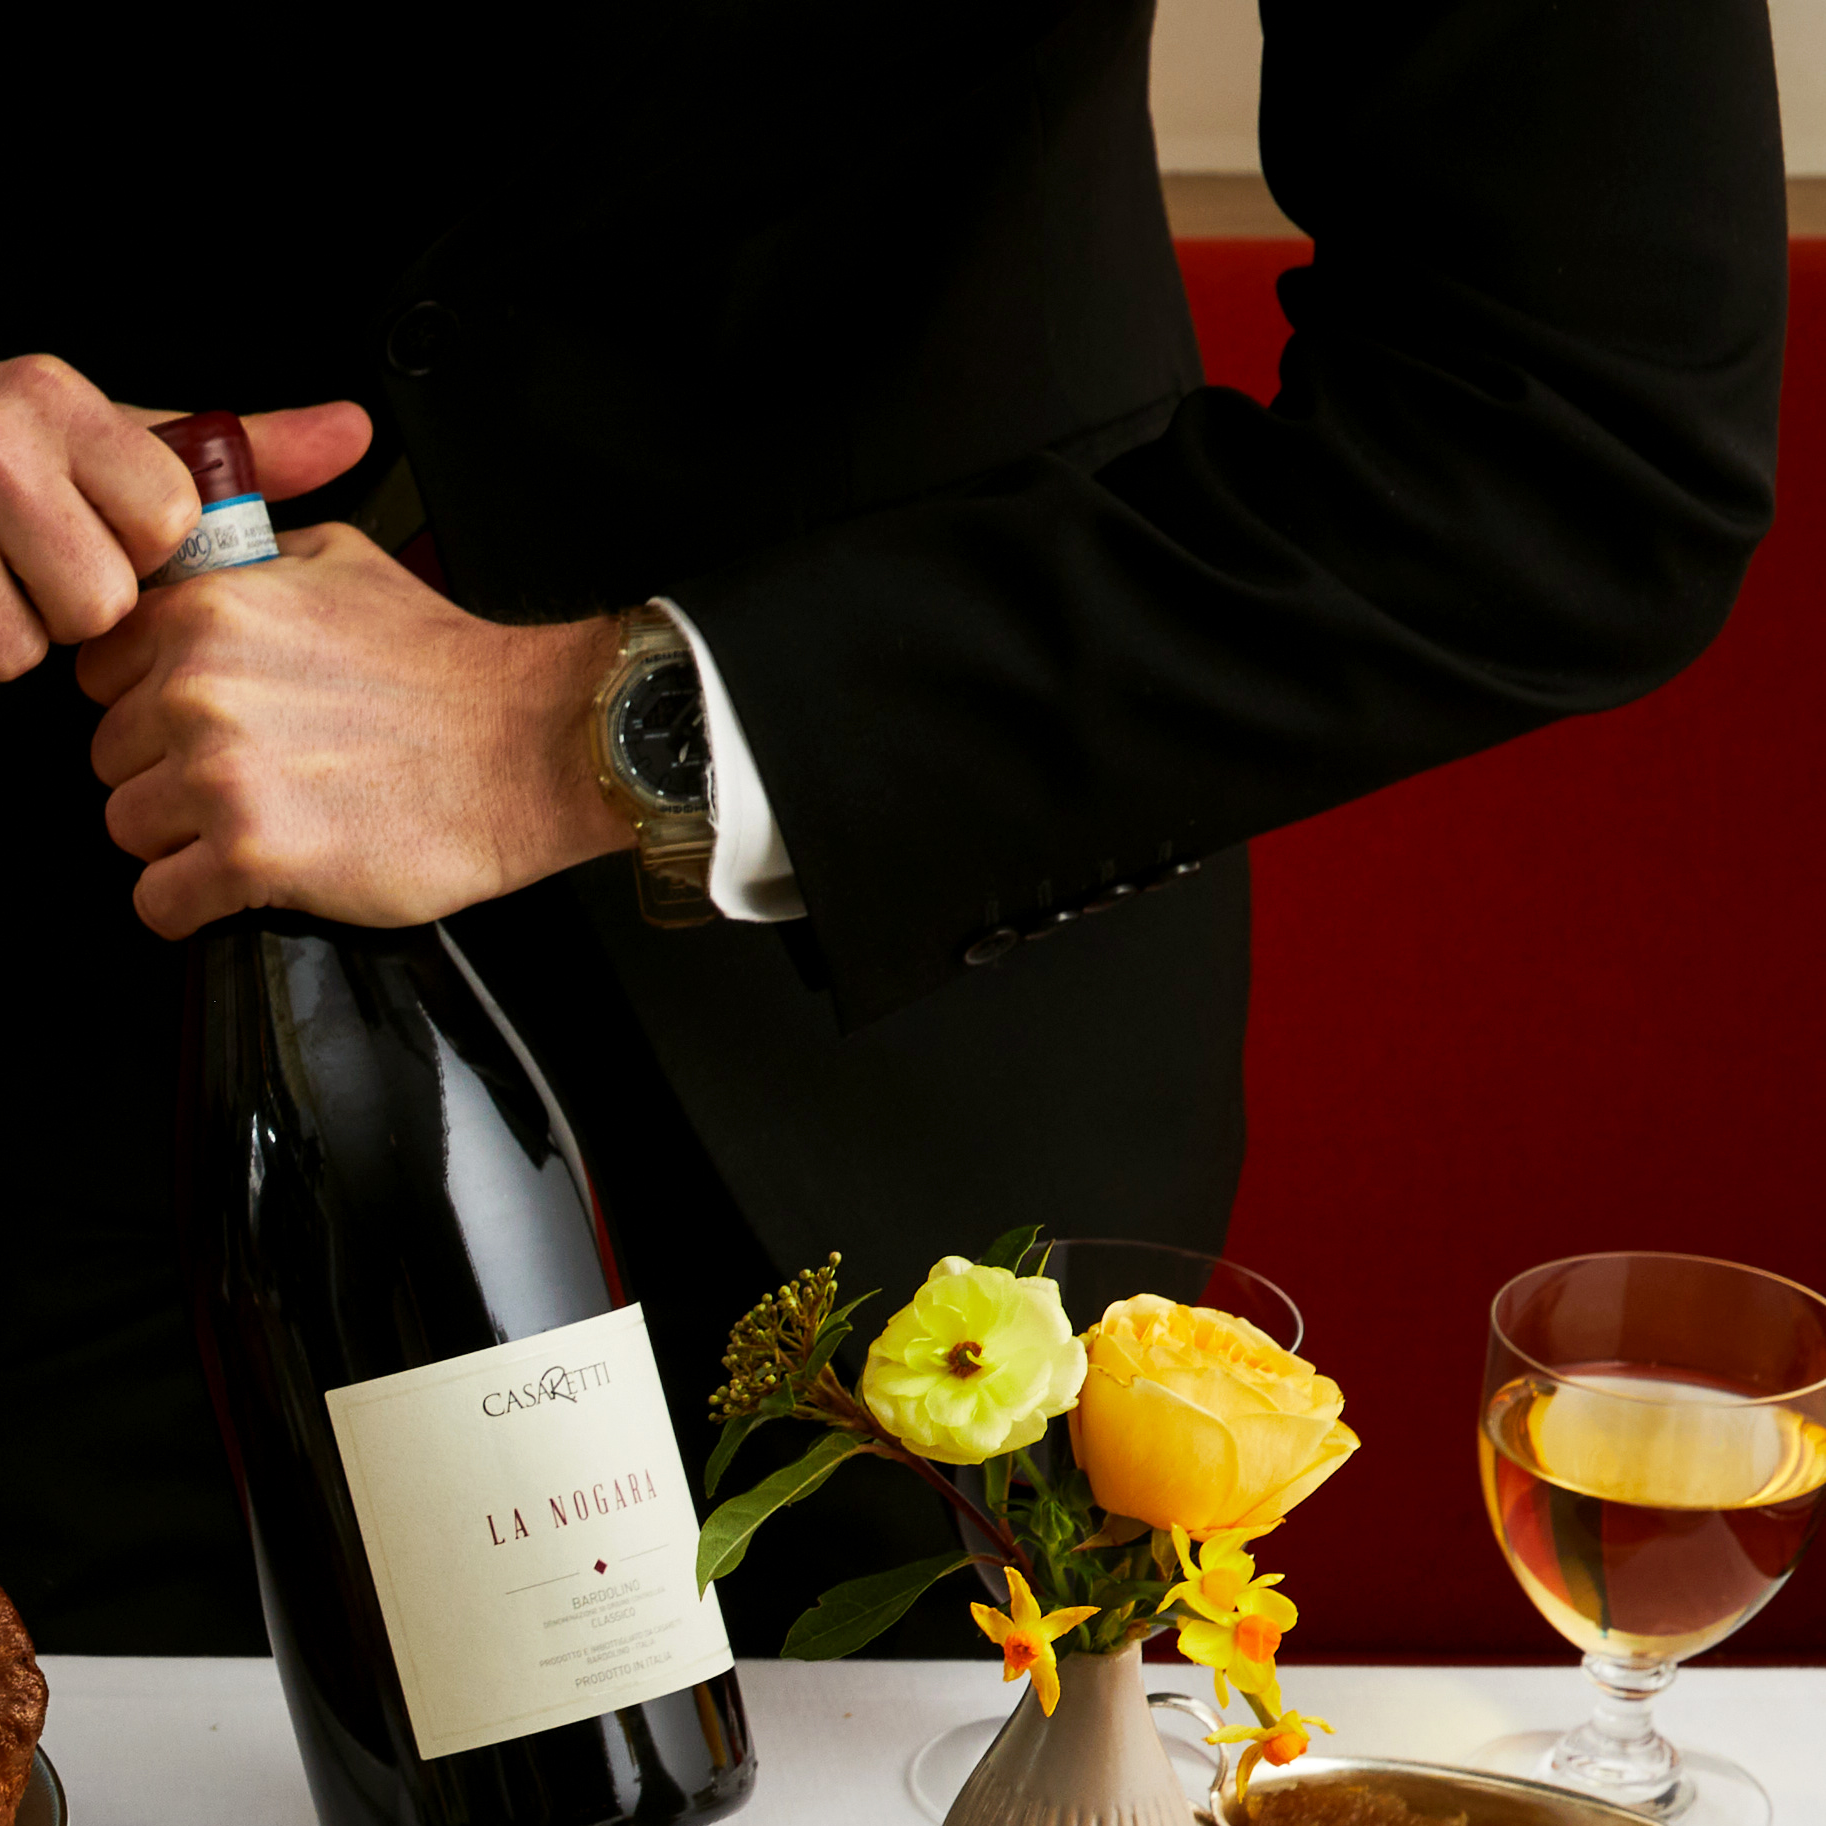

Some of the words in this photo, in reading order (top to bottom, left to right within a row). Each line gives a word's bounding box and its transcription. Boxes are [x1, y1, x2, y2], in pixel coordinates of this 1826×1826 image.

[486, 1508, 531, 1546] LA
[548, 1468, 659, 1529] NOGARA
[571, 1579, 641, 1609] BARDOLINO
[590, 1607, 637, 1628] CLASSICO
[575, 1665, 632, 1689] PRODOTTO
[632, 1661, 644, 1671] IN
[645, 1651, 673, 1667] ITALIA
